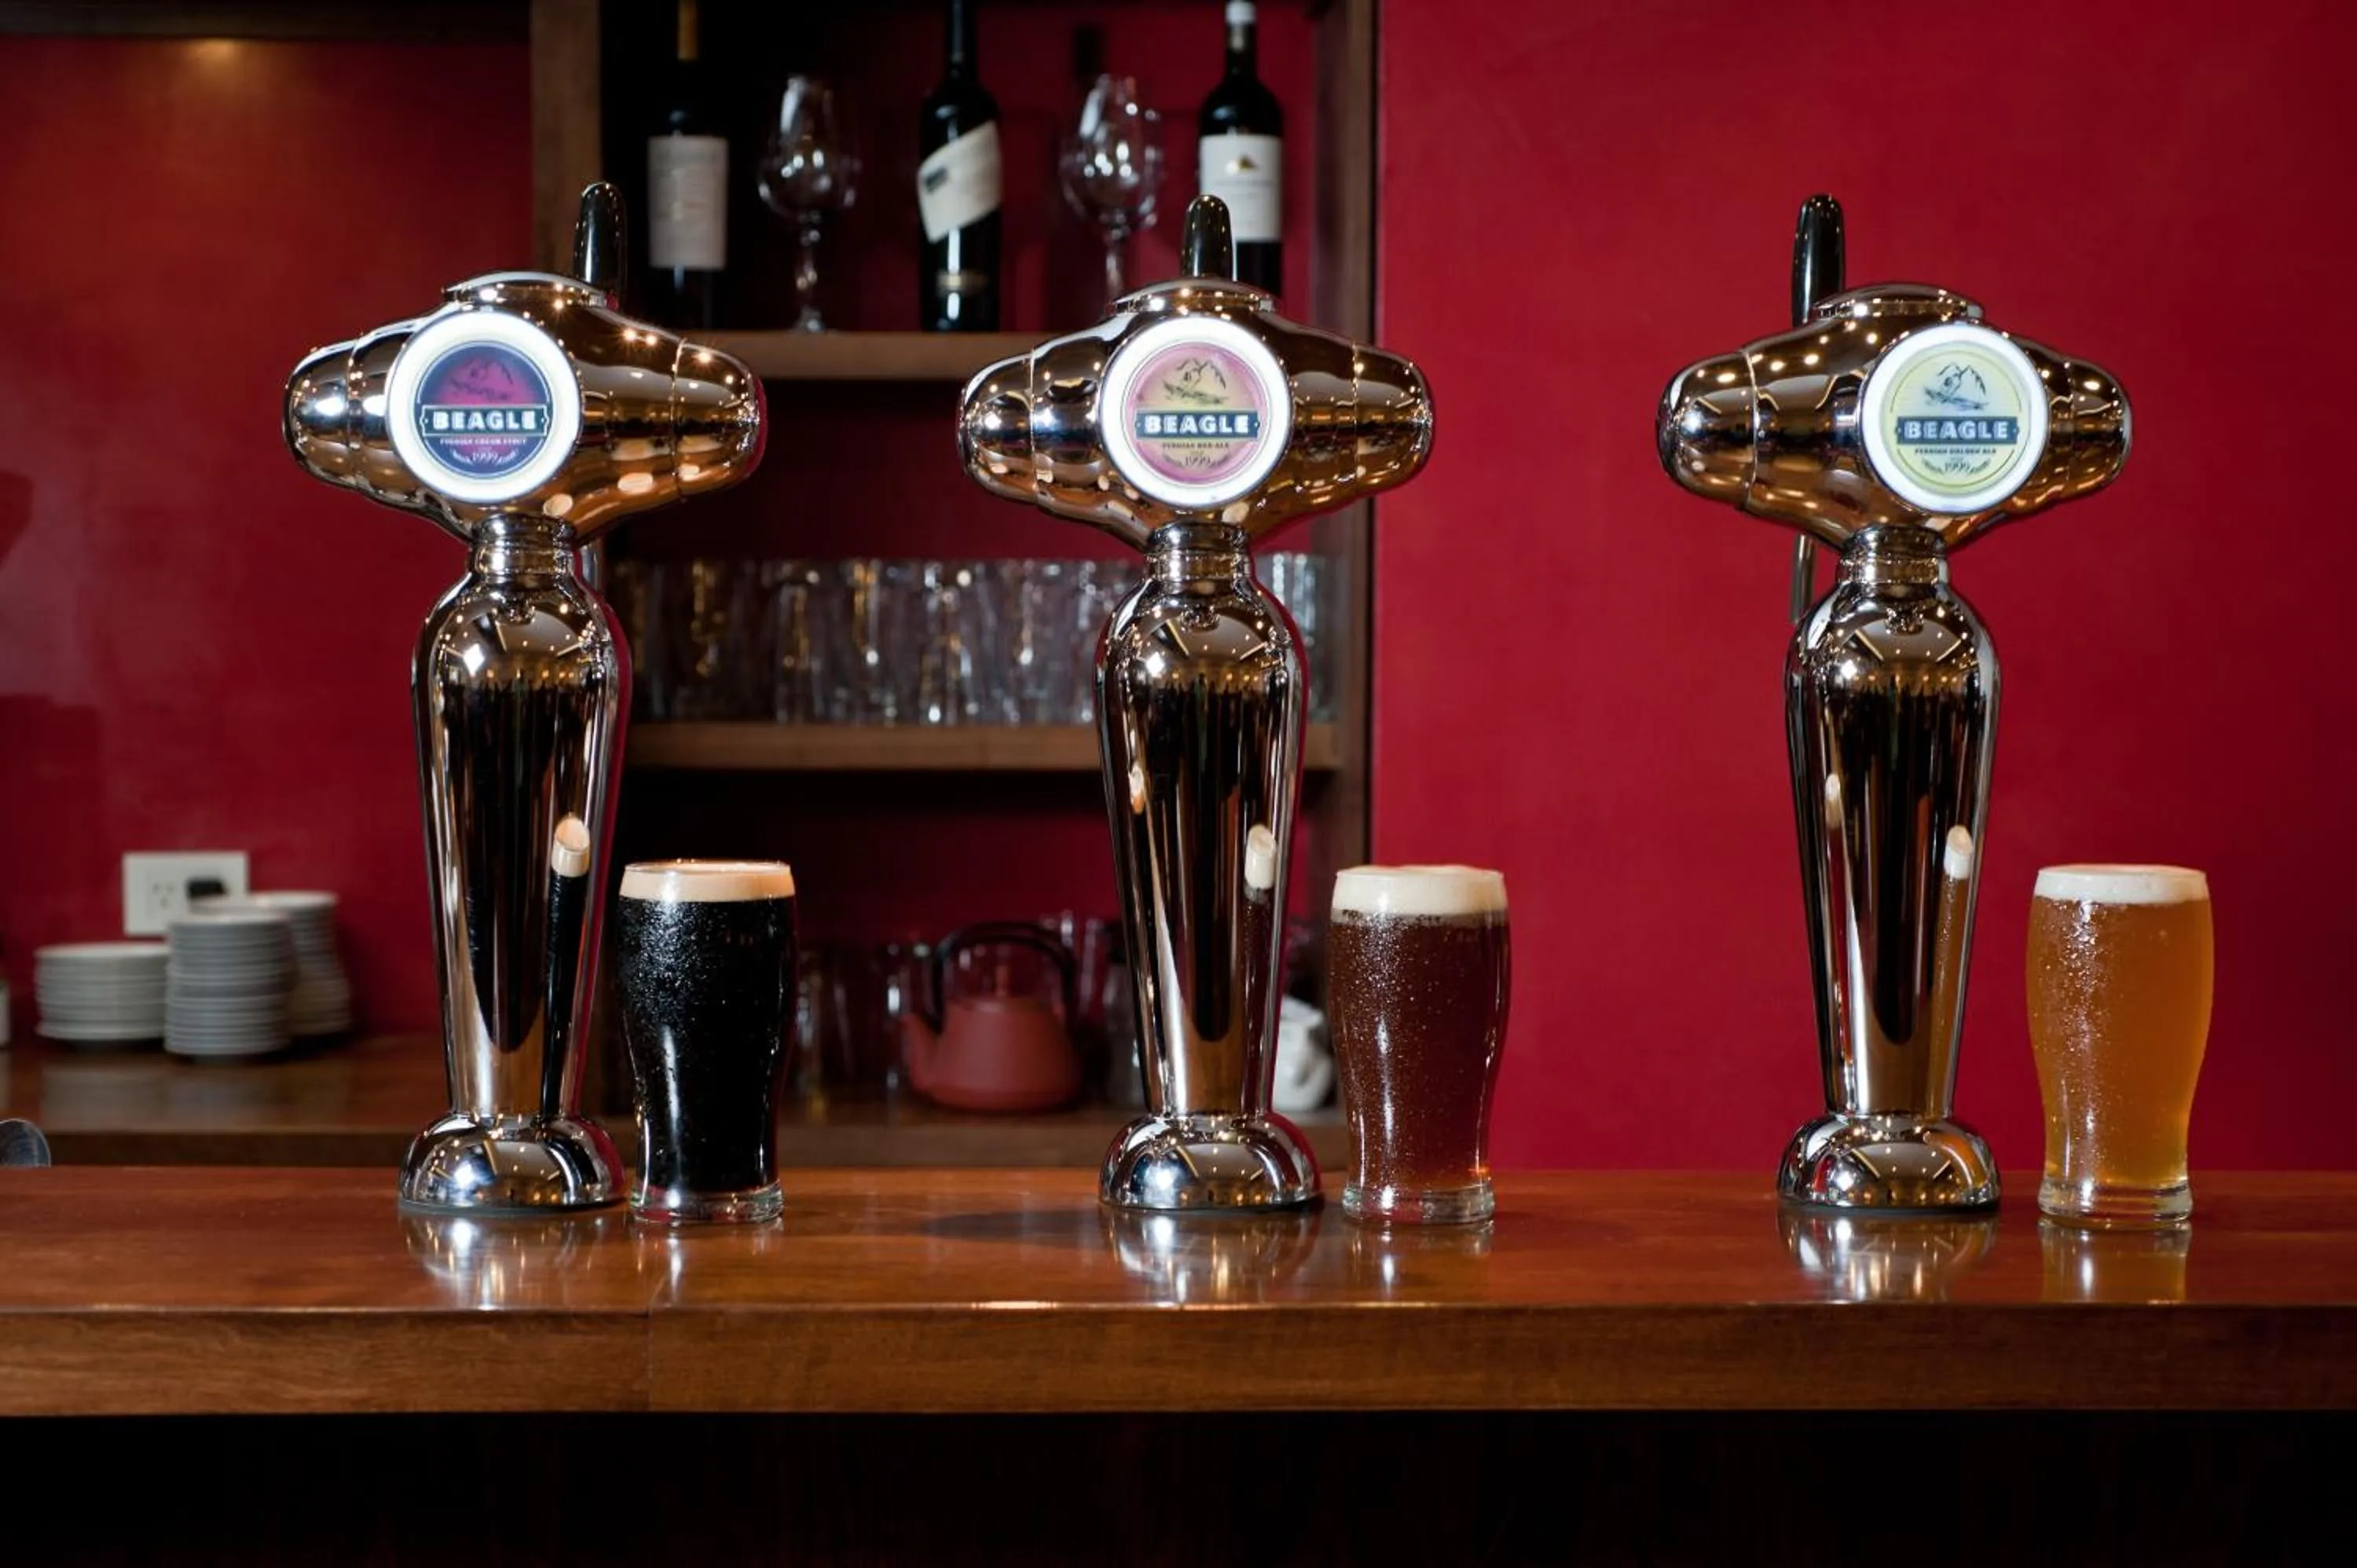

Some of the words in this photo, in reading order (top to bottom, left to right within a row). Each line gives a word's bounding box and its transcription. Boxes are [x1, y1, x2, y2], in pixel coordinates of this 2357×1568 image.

[433, 410, 536, 430] BEAGLE
[1144, 415, 1248, 434] BEAGLE
[1904, 420, 2008, 440] BEAGLE
